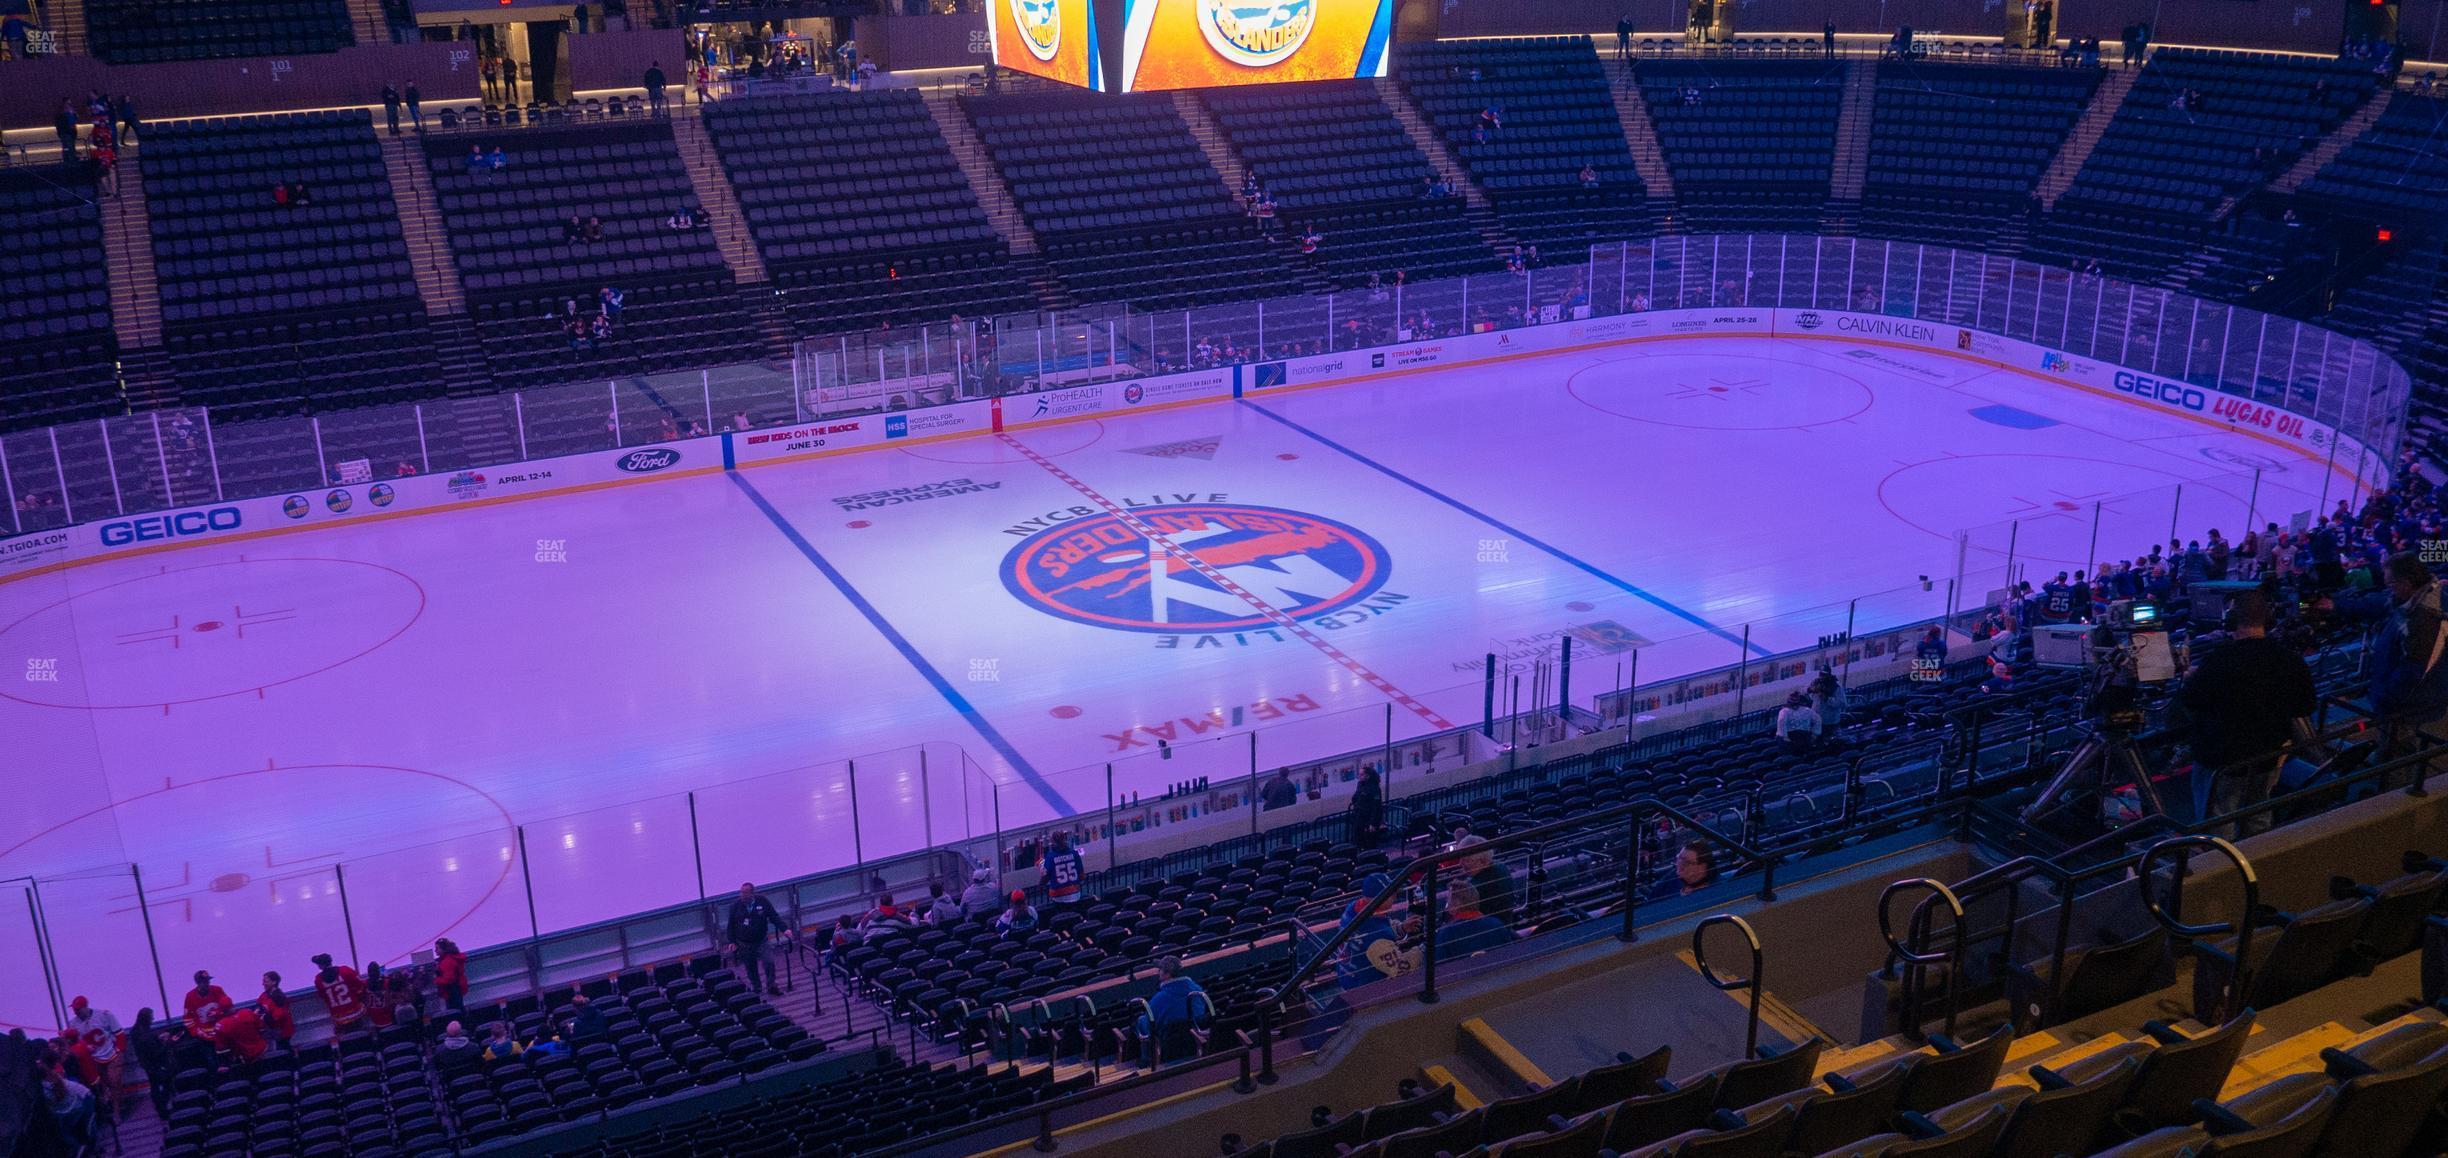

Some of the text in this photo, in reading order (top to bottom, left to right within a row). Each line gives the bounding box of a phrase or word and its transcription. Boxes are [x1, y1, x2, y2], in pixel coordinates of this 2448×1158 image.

[449, 50, 470, 61] 102
[271, 60, 292, 71] 101
[1586, 322, 1627, 333] HARMONY
[1838, 317, 1935, 341] CALVIN KLEIN
[1292, 360, 1343, 376] nationalgrid
[1051, 388, 1102, 402] ProHEALTH
[2114, 370, 2205, 411] GEICO
[1052, 402, 1101, 415] URGENT CARE
[909, 415, 938, 425] HOSPITAL
[910, 417, 965, 431] SPECIAL SURGERY
[2212, 396, 2271, 429] LUCAS
[2276, 416, 2304, 440] OIL
[771, 431, 792, 442] KIDS
[794, 430, 808, 439] ON
[810, 427, 826, 437] THE
[887, 422, 905, 432] HSS
[785, 439, 825, 451] JUNE 30
[627, 449, 671, 472] Ford
[498, 471, 552, 485] APRIL 12-14
[832, 478, 974, 506] EXPRESS
[841, 481, 1001, 512] AMERICAN
[1002, 493, 1230, 538] NYCB LIVE
[100, 506, 242, 547] GEICO
[2050, 597, 2069, 612] 25
[1154, 590, 1410, 649] NYCB LIVE
[1102, 693, 1321, 752] RE/MAX
[1055, 861, 1078, 884] 55
[325, 984, 352, 1008] 12
